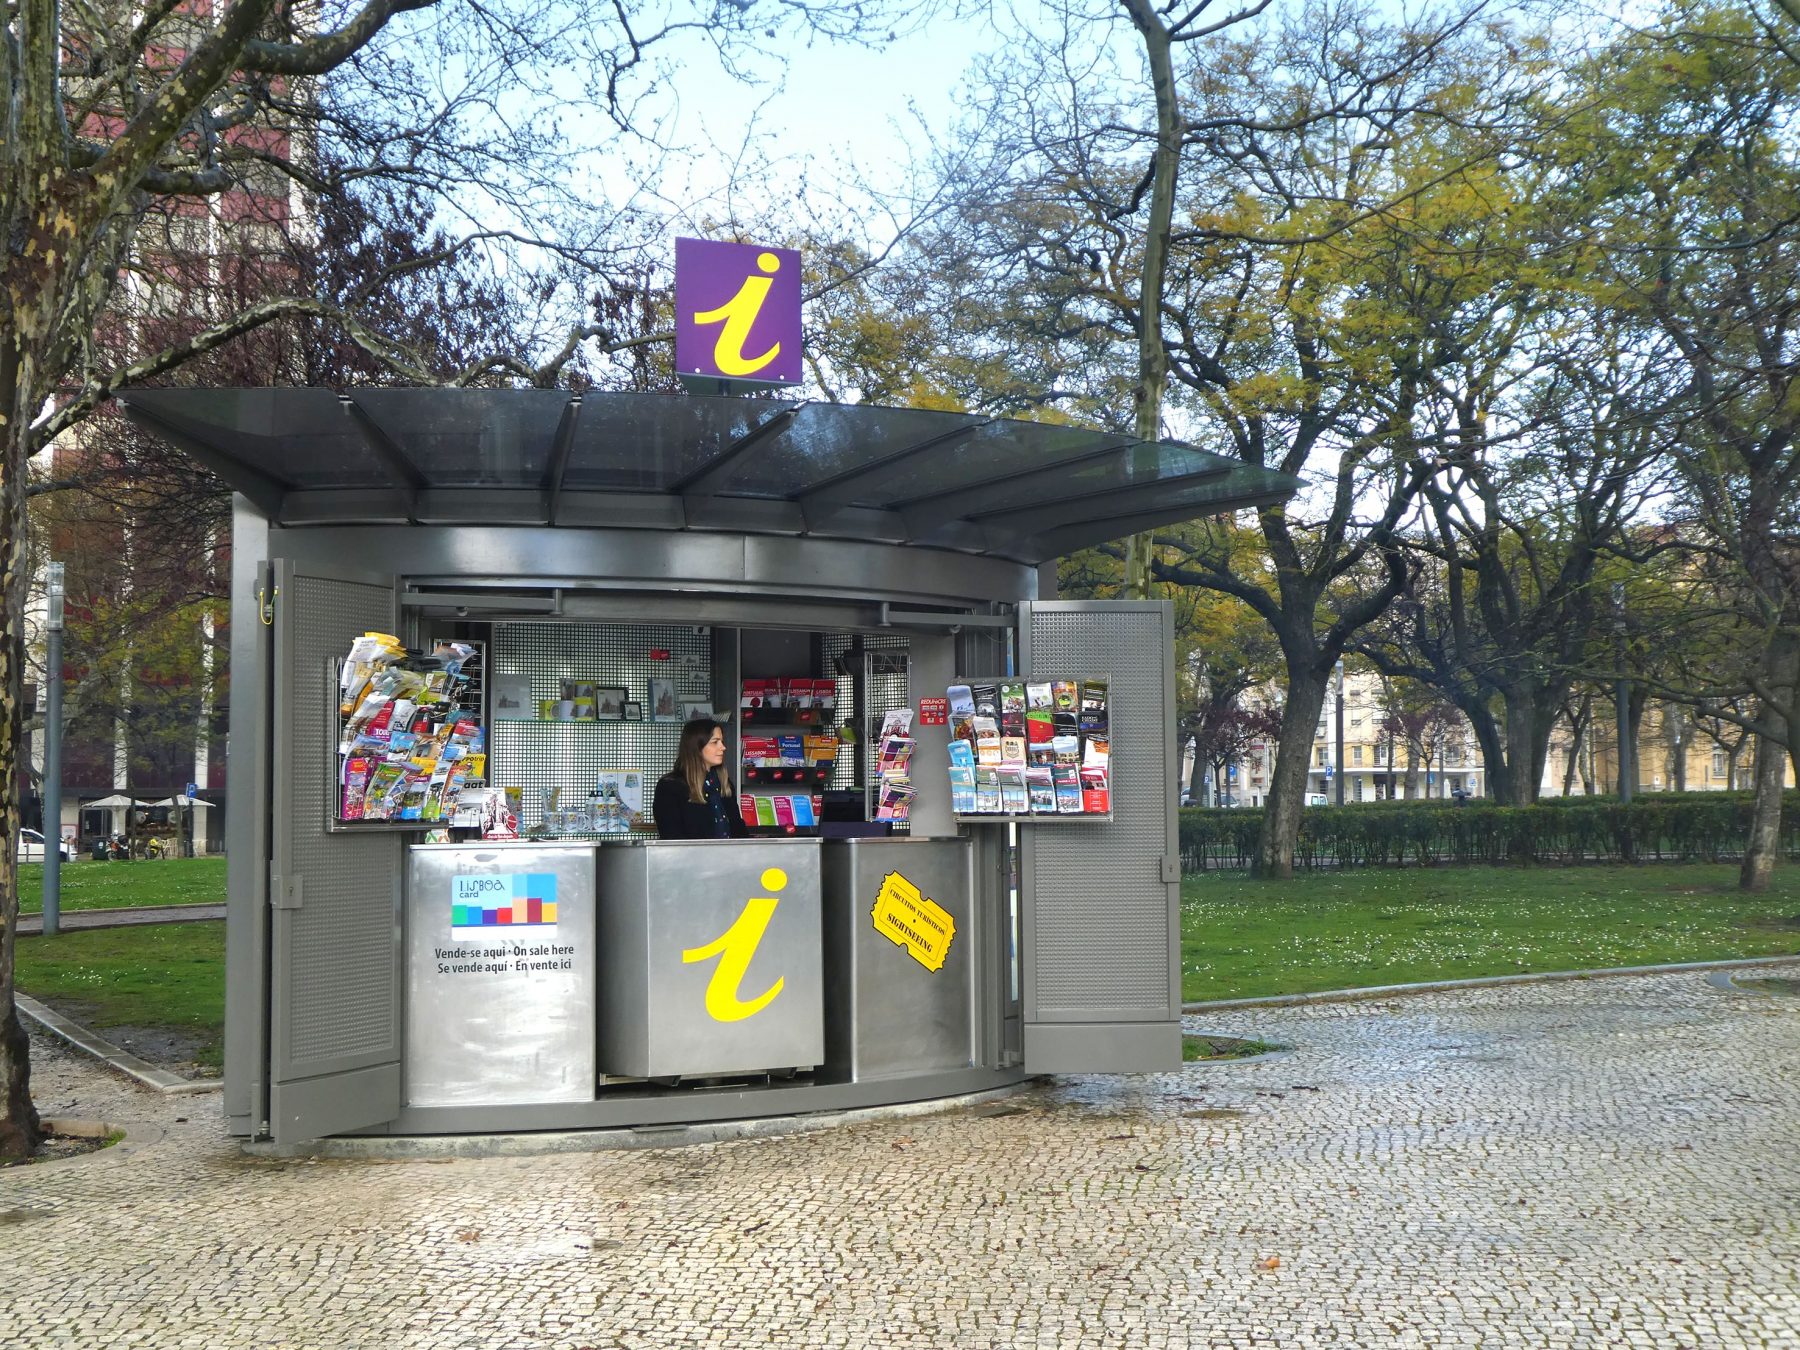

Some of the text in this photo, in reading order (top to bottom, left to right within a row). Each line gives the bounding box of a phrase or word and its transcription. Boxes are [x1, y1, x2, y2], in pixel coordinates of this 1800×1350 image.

[694, 252, 781, 376] i
[459, 891, 479, 899] card
[889, 889, 916, 913] CIRCUITOS
[682, 867, 788, 1022] i
[887, 913, 933, 953] SIGHTSEEING
[435, 944, 575, 960] Vende-se aqui On sale here
[437, 958, 572, 975] Se vende aquí En vente ici
